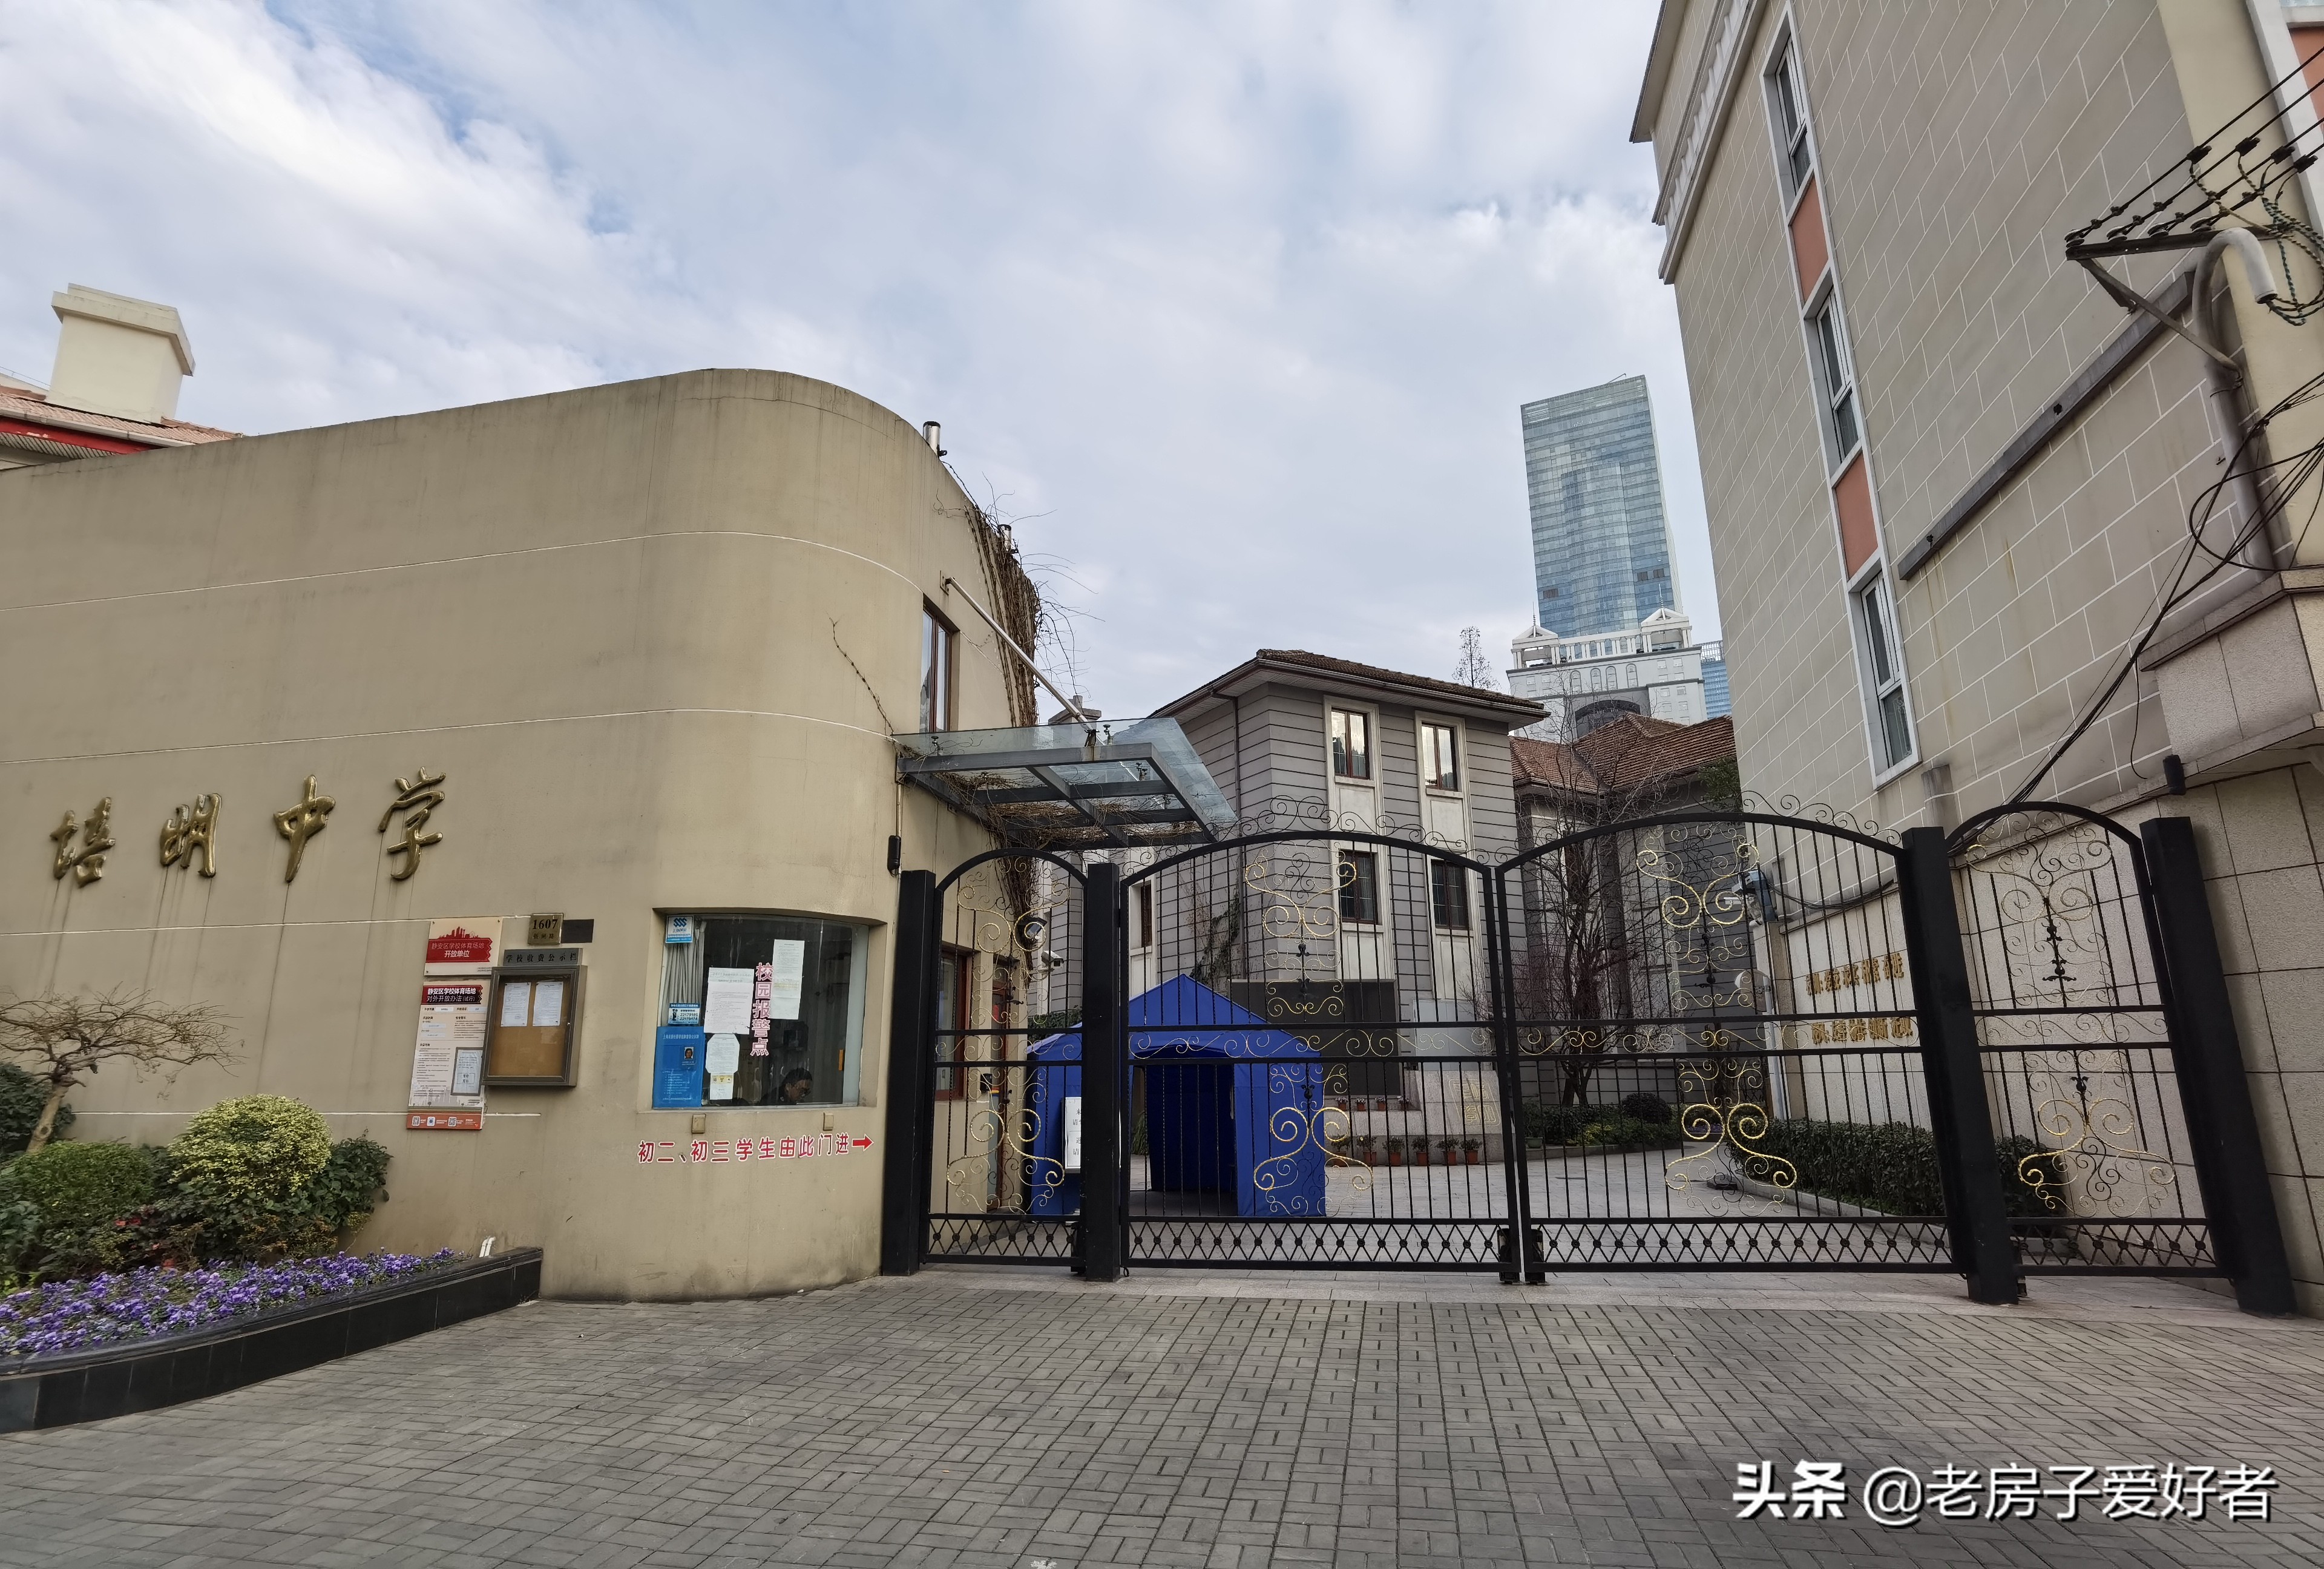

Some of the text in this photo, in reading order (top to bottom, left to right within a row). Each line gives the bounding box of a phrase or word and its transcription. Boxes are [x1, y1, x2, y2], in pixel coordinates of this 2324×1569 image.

[533, 918, 559, 930] 1607
[506, 952, 577, 962] 学校收费公示栏
[750, 962, 773, 1056] 校园报警点
[637, 1133, 850, 1163] 初二、初三学生由此门进
